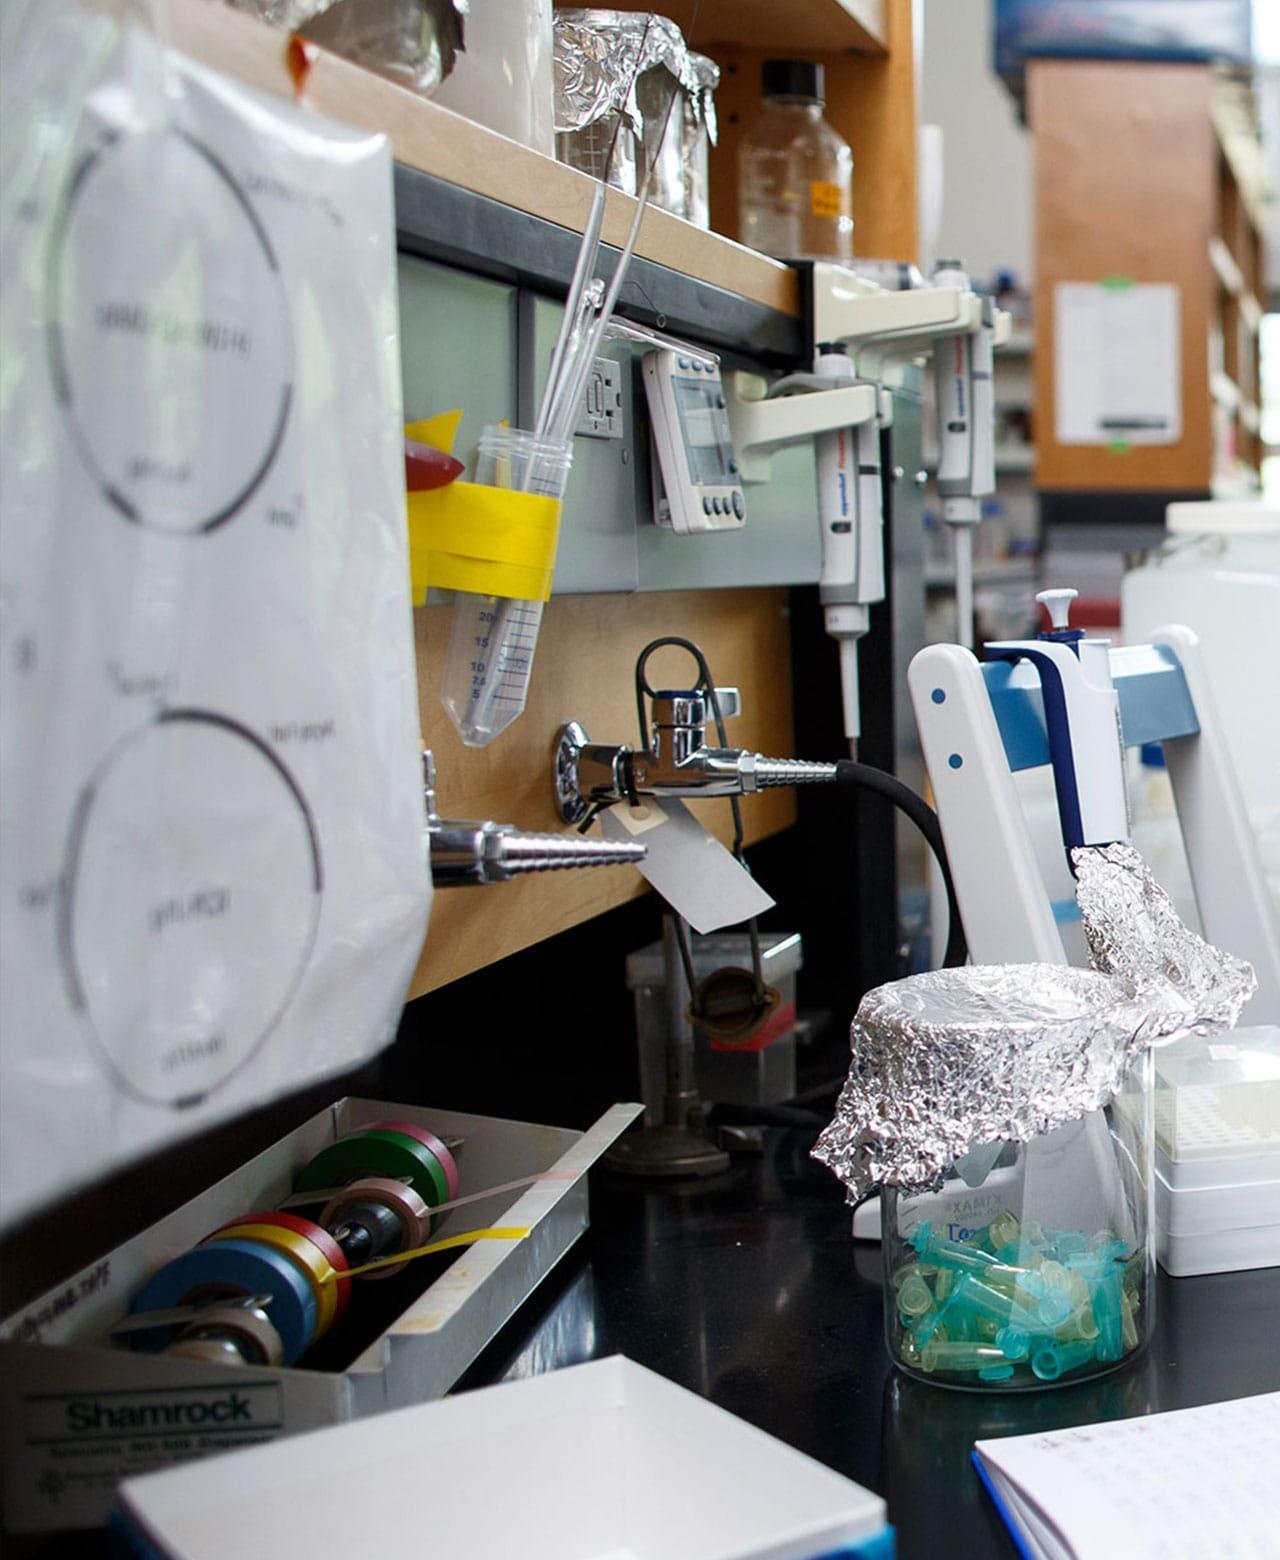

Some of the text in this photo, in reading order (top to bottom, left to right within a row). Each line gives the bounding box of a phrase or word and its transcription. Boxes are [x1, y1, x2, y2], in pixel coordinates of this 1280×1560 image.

[474, 636, 489, 649] 15
[471, 661, 486, 673] 10
[66, 1392, 253, 1432] Shamrock
